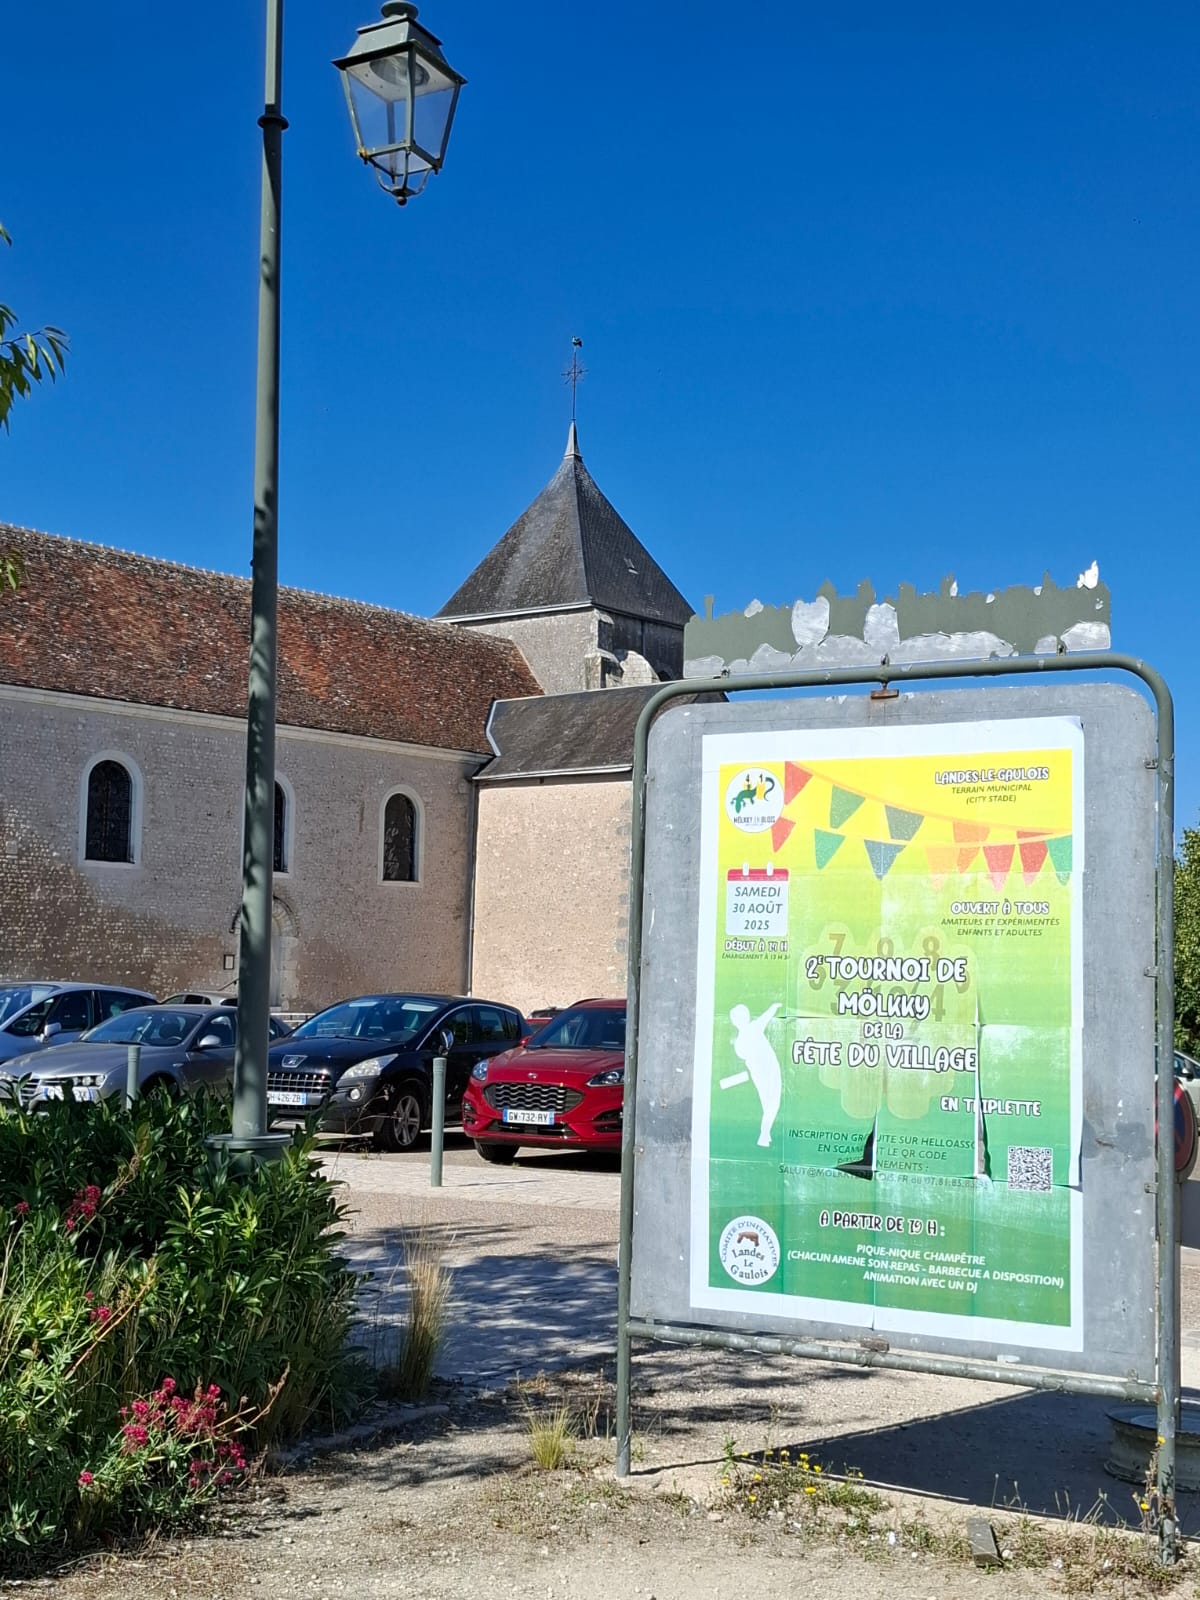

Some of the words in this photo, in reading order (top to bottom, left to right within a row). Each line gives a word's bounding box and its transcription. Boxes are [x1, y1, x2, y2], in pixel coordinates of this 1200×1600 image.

[935, 767, 1049, 784] LANDES-LE-GAULOIS
[952, 786, 985, 794] TERRAIN
[986, 784, 1033, 793] MUNICIPAL
[966, 796, 987, 805] (CITY
[989, 795, 1017, 804] STADE)
[735, 886, 781, 897] SAMEDI
[732, 903, 746, 913] 30
[747, 900, 783, 914] AOÛT
[951, 901, 1000, 914] OUVERT
[1002, 898, 1012, 915] À
[1014, 901, 1049, 914] TOUS
[744, 919, 770, 930] 2025
[941, 918, 983, 926] AMATEURS
[985, 918, 995, 926] ET
[997, 917, 1060, 926] EXPÉRIMENTÉS
[957, 929, 993, 937] ENFANTS
[995, 929, 1004, 937] ET
[1006, 929, 1043, 937] ADULTES
[725, 937, 757, 952] DÉBUT
[780, 941, 789, 952] H
[825, 957, 930, 982] TOURNOI
[936, 958, 968, 982] DE
[838, 988, 930, 1020] MÖLKKY
[863, 1022, 882, 1039] DE
[885, 1023, 903, 1041] LA
[792, 1037, 842, 1066] FÊTE
[848, 1042, 880, 1067] DU
[885, 1044, 977, 1073] VILLAGE
[940, 1096, 959, 1112] EN
[508, 1111, 548, 1122] GW-732-AY
[788, 1129, 848, 1141] INSCRIPTION
[899, 1136, 919, 1145] SUR
[817, 1143, 831, 1152] EN
[887, 1147, 899, 1156] LE
[901, 1148, 916, 1158] QR
[918, 1150, 947, 1160] CODE
[820, 1210, 829, 1227] A
[833, 1211, 882, 1231] PARTIR
[886, 1216, 904, 1232] DE
[908, 1218, 923, 1235] 19
[927, 1220, 938, 1236] H
[731, 1247, 765, 1261] Landes
[856, 1244, 921, 1261] PIQUE-NIQUE
[923, 1250, 986, 1266] CHAMPÊTRE
[744, 1258, 754, 1267] Le
[787, 1250, 831, 1263] (CHACUN
[831, 1254, 866, 1267] AMENE
[867, 1258, 889, 1269] SON
[890, 1261, 921, 1273] REPAS
[928, 1264, 982, 1279] BARBECUE
[983, 1269, 990, 1279] A
[993, 1271, 1065, 1289] DISPOSITION)
[730, 1264, 769, 1279] Gaulois
[863, 1271, 919, 1286] ANIMATION
[920, 1277, 946, 1290] AVEC
[948, 1280, 964, 1290] UN
[966, 1281, 978, 1293] DJ
